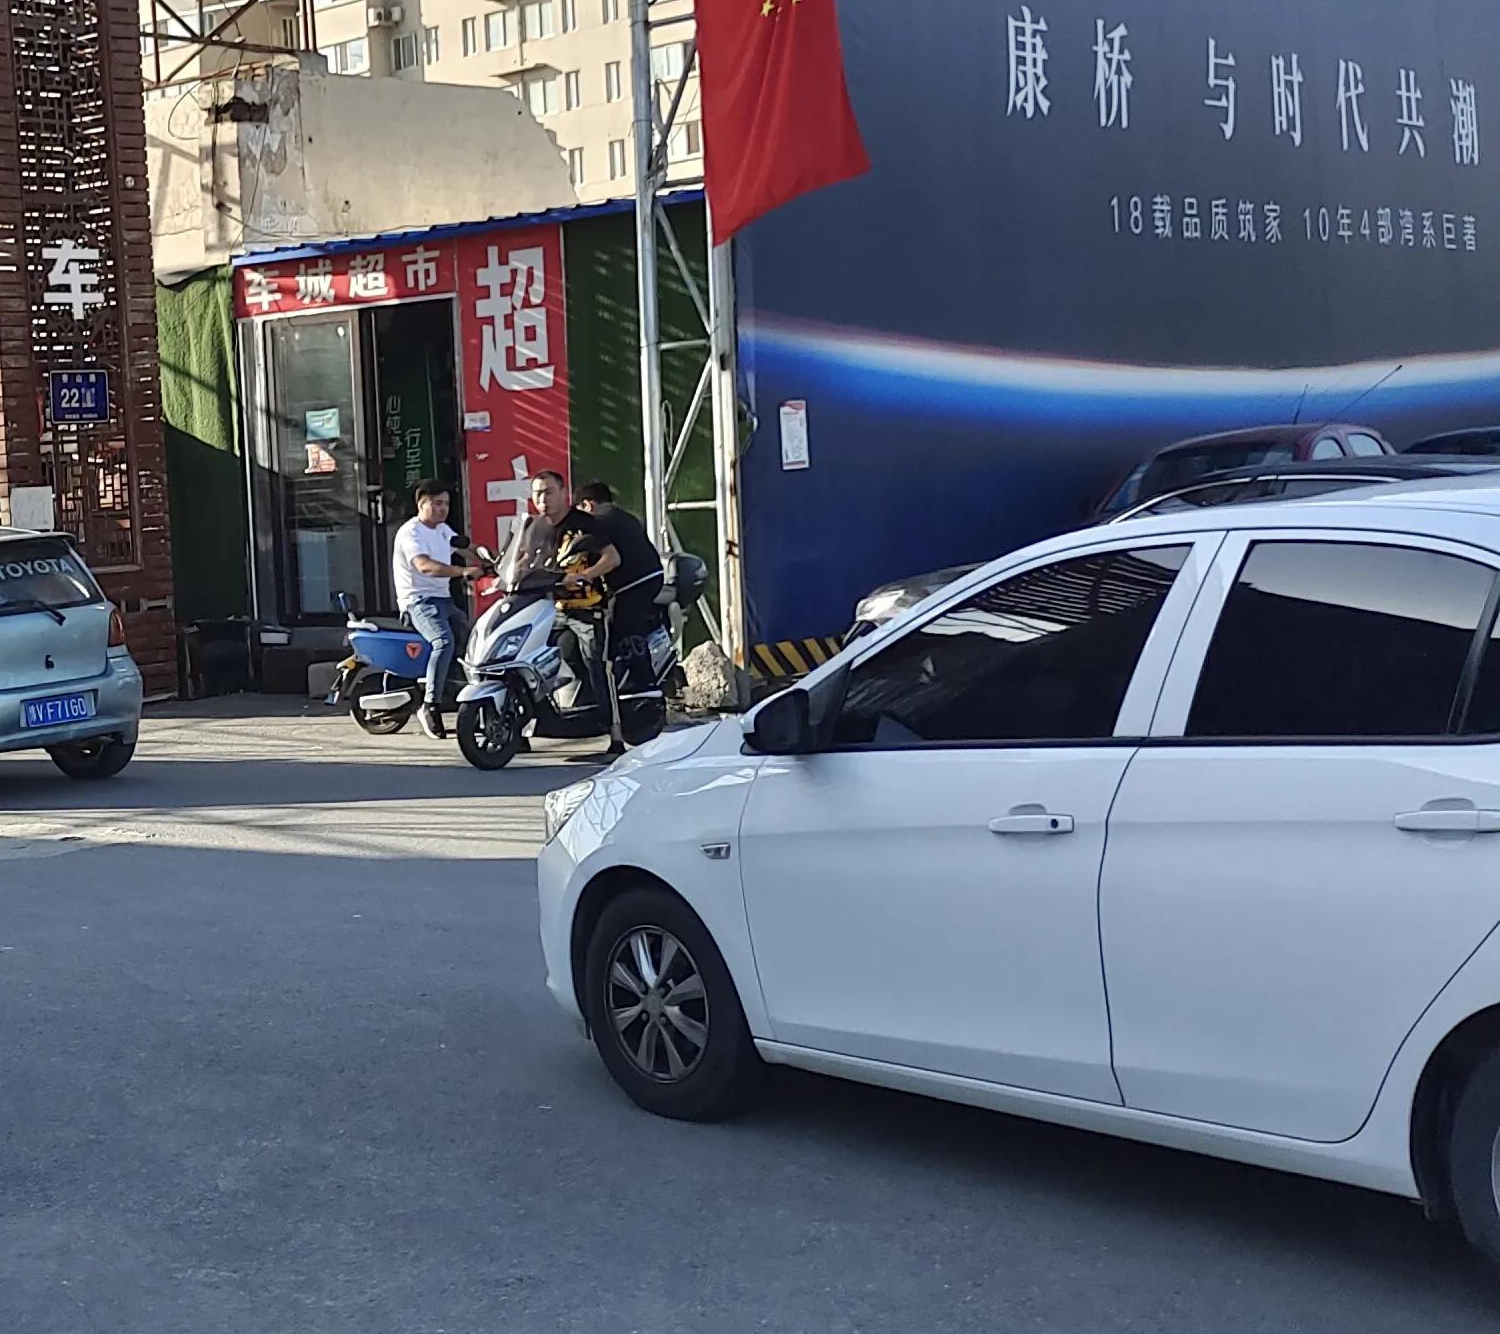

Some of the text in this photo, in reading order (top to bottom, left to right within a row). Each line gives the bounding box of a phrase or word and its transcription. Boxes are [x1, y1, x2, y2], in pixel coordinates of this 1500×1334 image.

[1110, 194, 1282, 244] 18载品质筑家
[41, 238, 105, 321] 车
[243, 244, 440, 312] 车城超市
